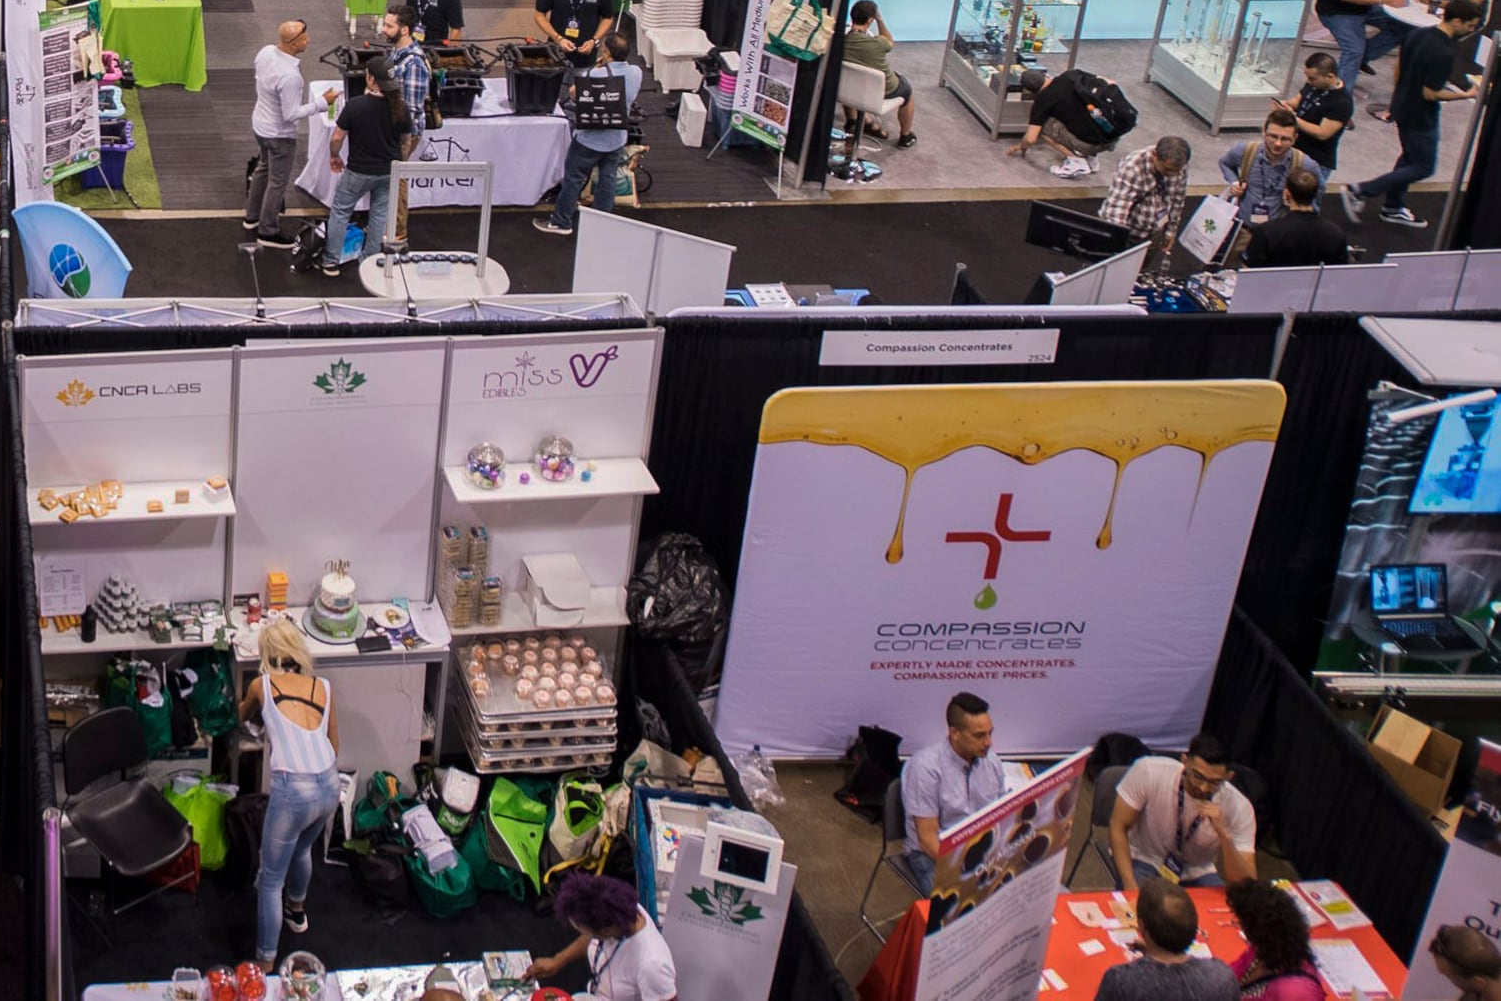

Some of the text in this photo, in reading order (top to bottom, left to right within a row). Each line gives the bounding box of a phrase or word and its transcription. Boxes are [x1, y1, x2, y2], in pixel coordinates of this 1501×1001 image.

[748, 33, 759, 48] All
[742, 49, 757, 75] With
[737, 77, 753, 108] Works
[865, 341, 1013, 355] Compassion Concentrates
[1027, 354, 1052, 363] 2524
[484, 366, 564, 390] miss
[482, 386, 528, 399] EDIBLES
[876, 620, 1086, 637] COMPASSION
[872, 637, 1082, 652] concentrates
[870, 658, 1077, 670] EXPERTLY MADE CONCENTRATES.
[893, 670, 1049, 682] COMPASSIONATE PRICES.
